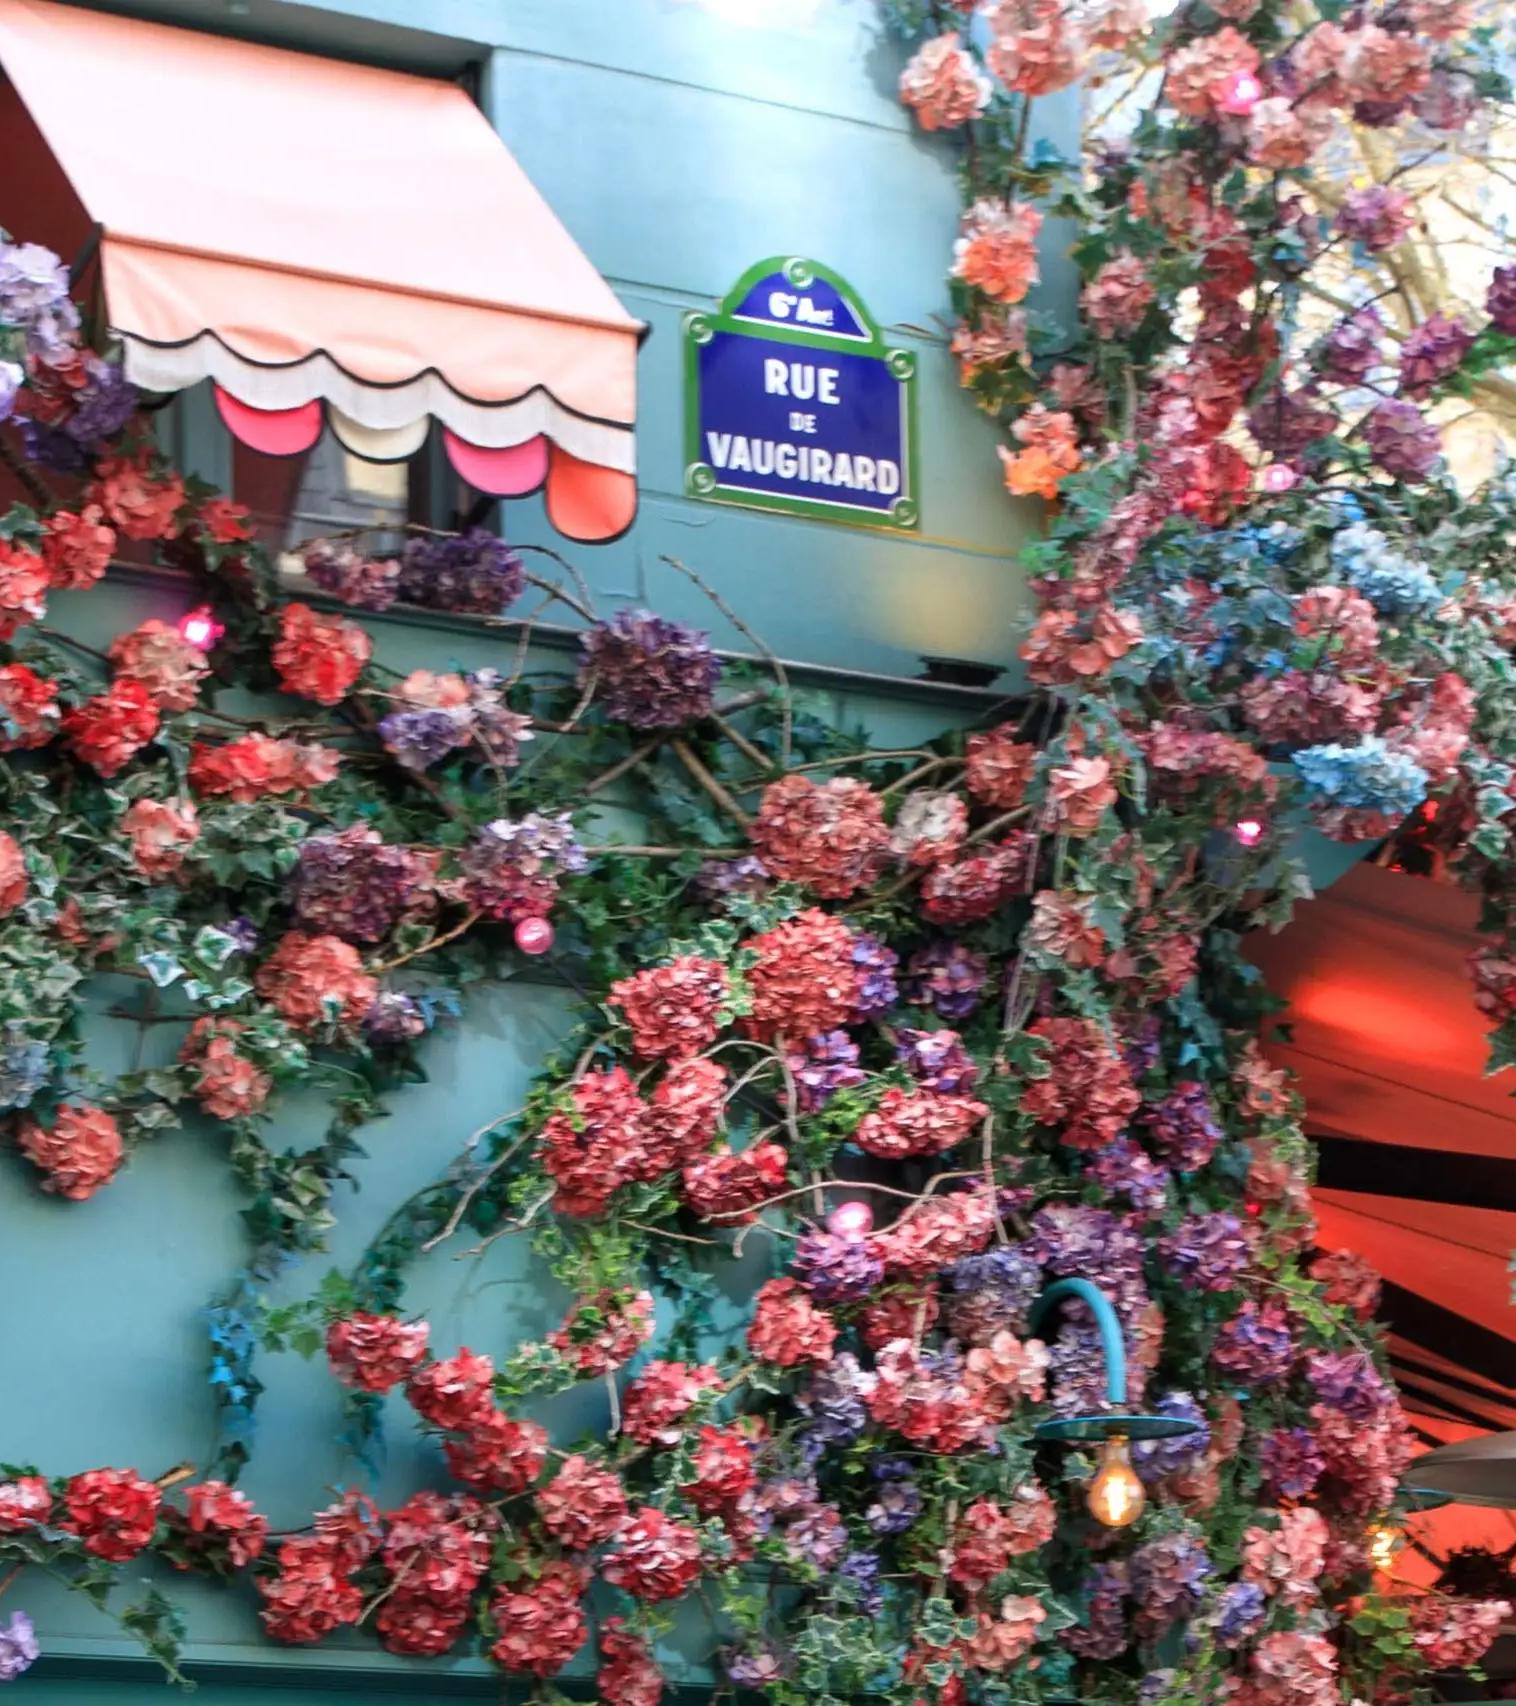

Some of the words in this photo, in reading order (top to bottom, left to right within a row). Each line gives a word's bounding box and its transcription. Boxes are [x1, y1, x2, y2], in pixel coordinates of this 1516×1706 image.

[764, 358, 840, 405] RUE
[788, 411, 817, 433] DE
[706, 431, 901, 495] VAUGIRARD
